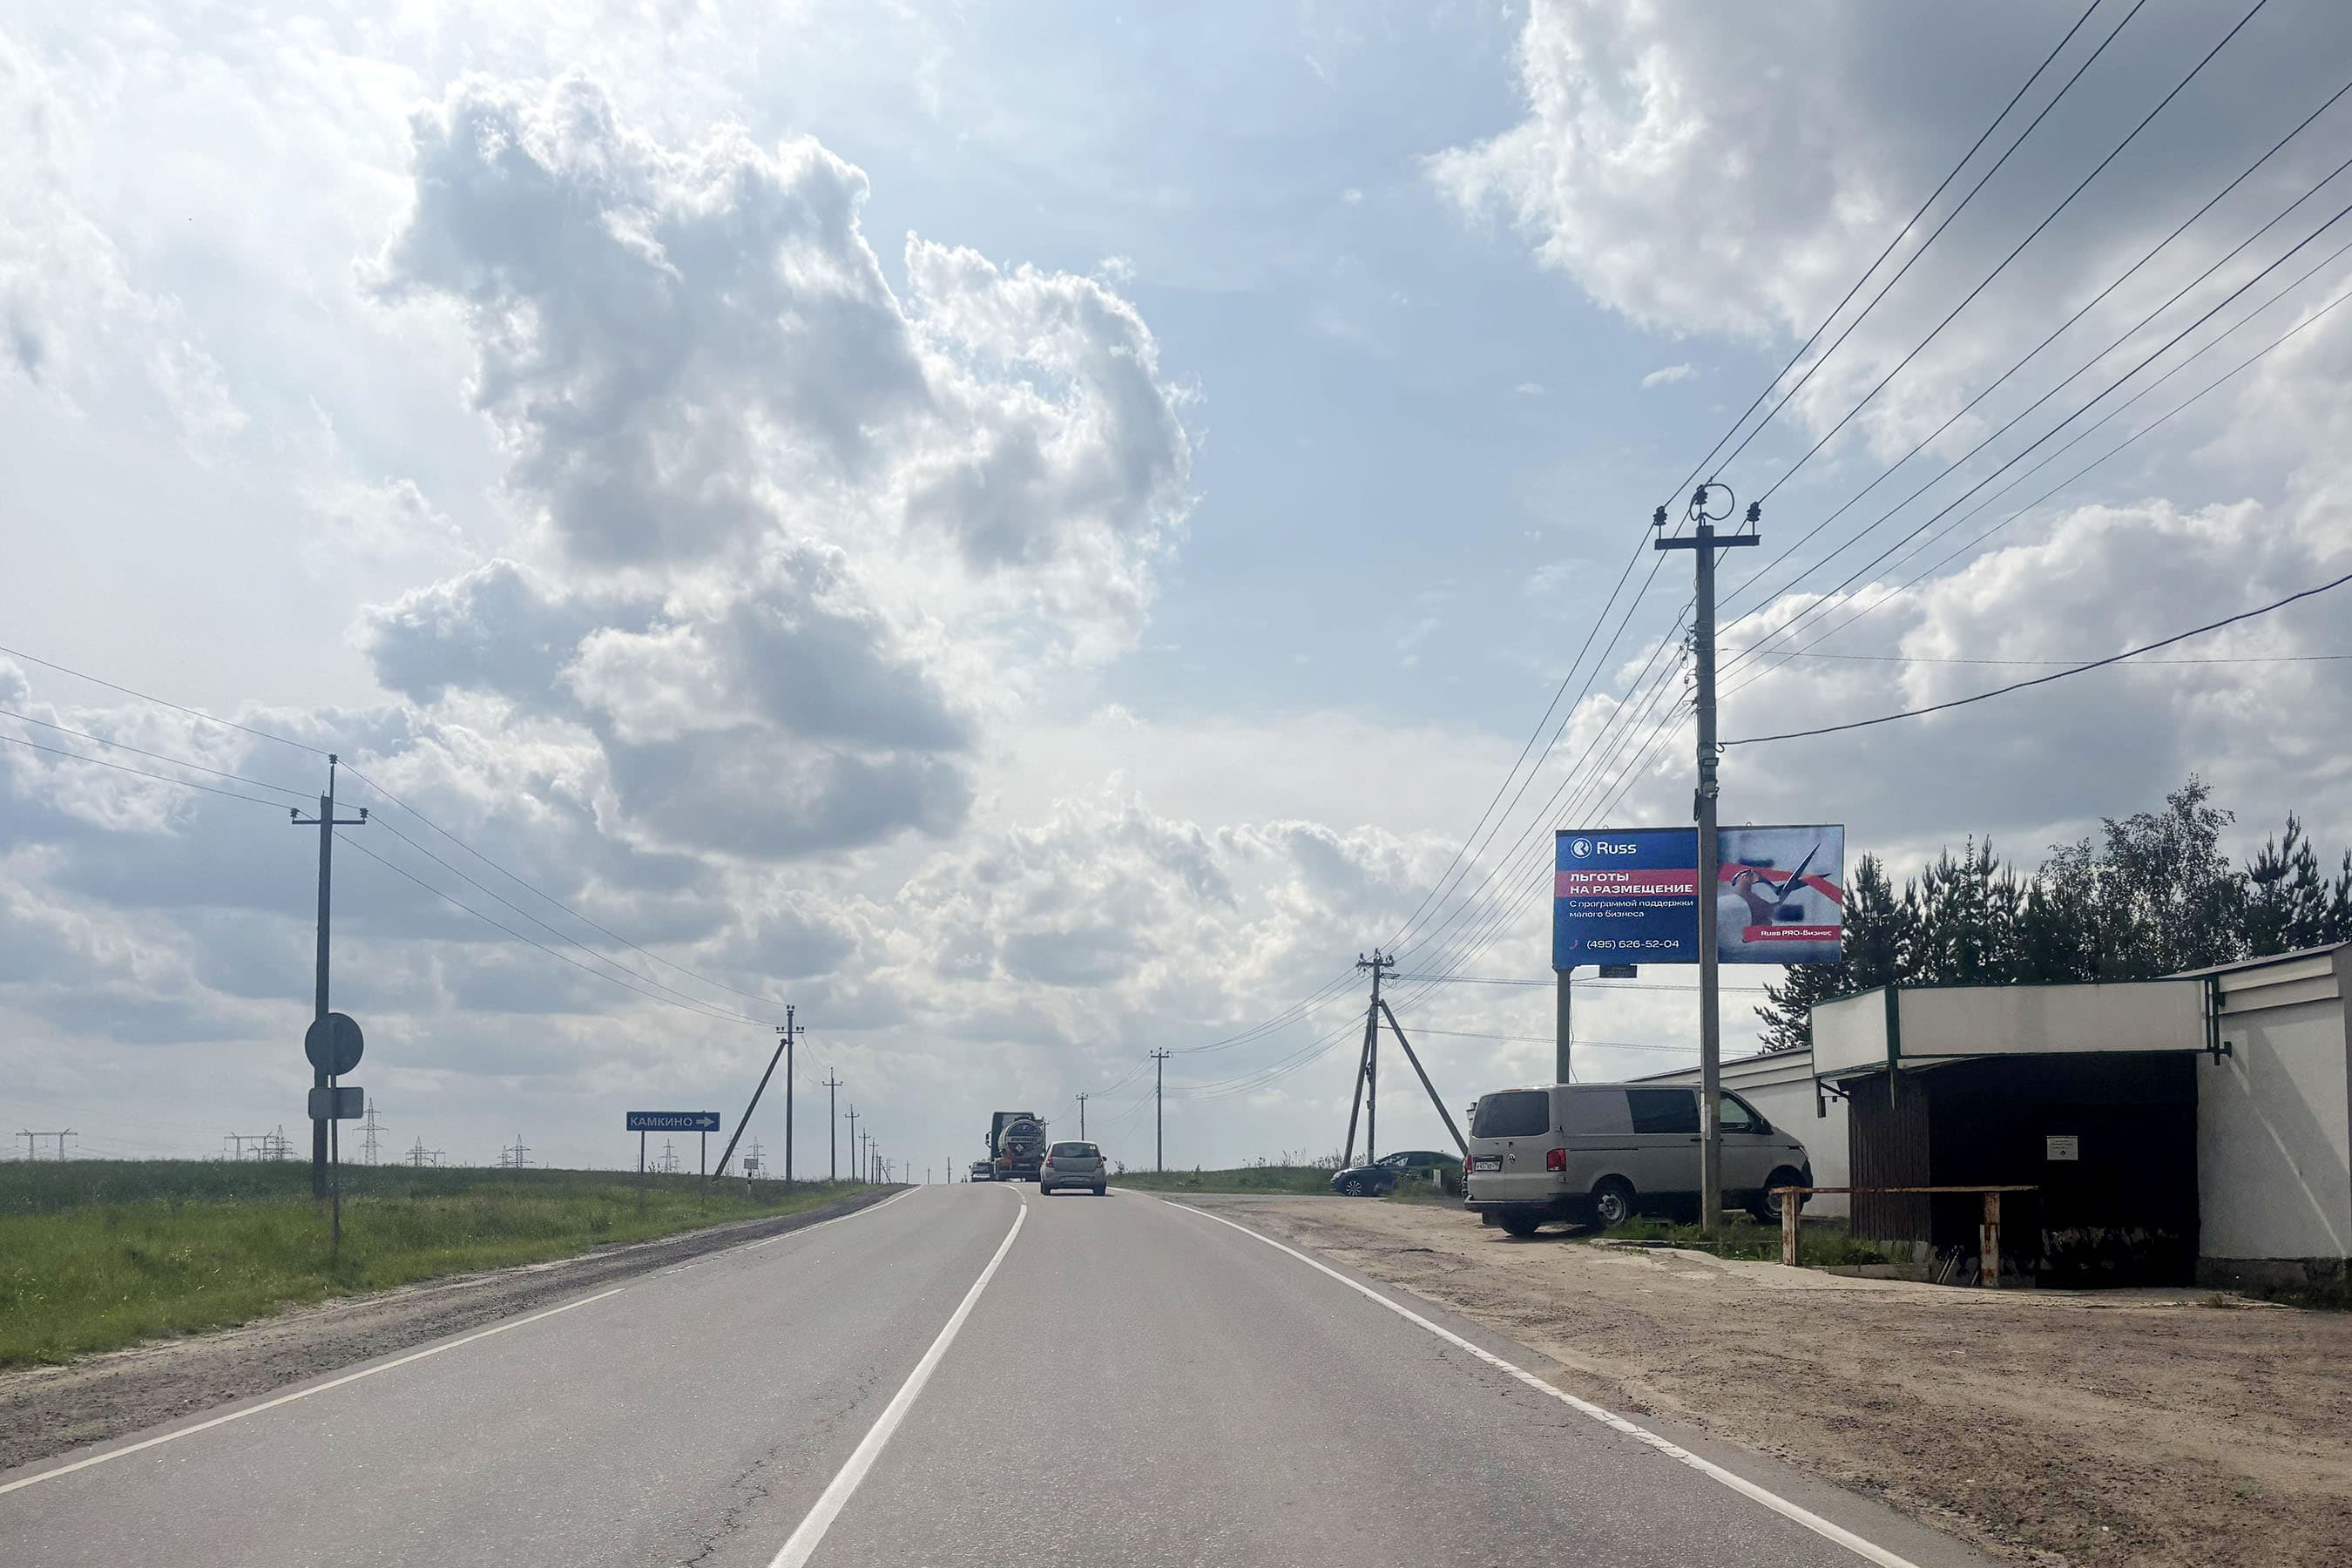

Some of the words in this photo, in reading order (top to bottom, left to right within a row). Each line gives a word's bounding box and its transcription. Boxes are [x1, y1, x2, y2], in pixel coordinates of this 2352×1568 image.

[1597, 841, 1637, 855] Russ
[1570, 873, 1629, 882] ЛЬГОТЫ
[1570, 885, 1590, 895] НА
[1592, 884, 1693, 895] РАЗМЕЩЕНИЕ
[1578, 899, 1638, 909] программой
[1639, 900, 1693, 909] поддержки
[1605, 909, 1645, 918] бизнеса
[1586, 940, 1617, 950] (495)
[1619, 940, 1680, 950] 626-52-04
[630, 1117, 693, 1126] КАМКИНО
